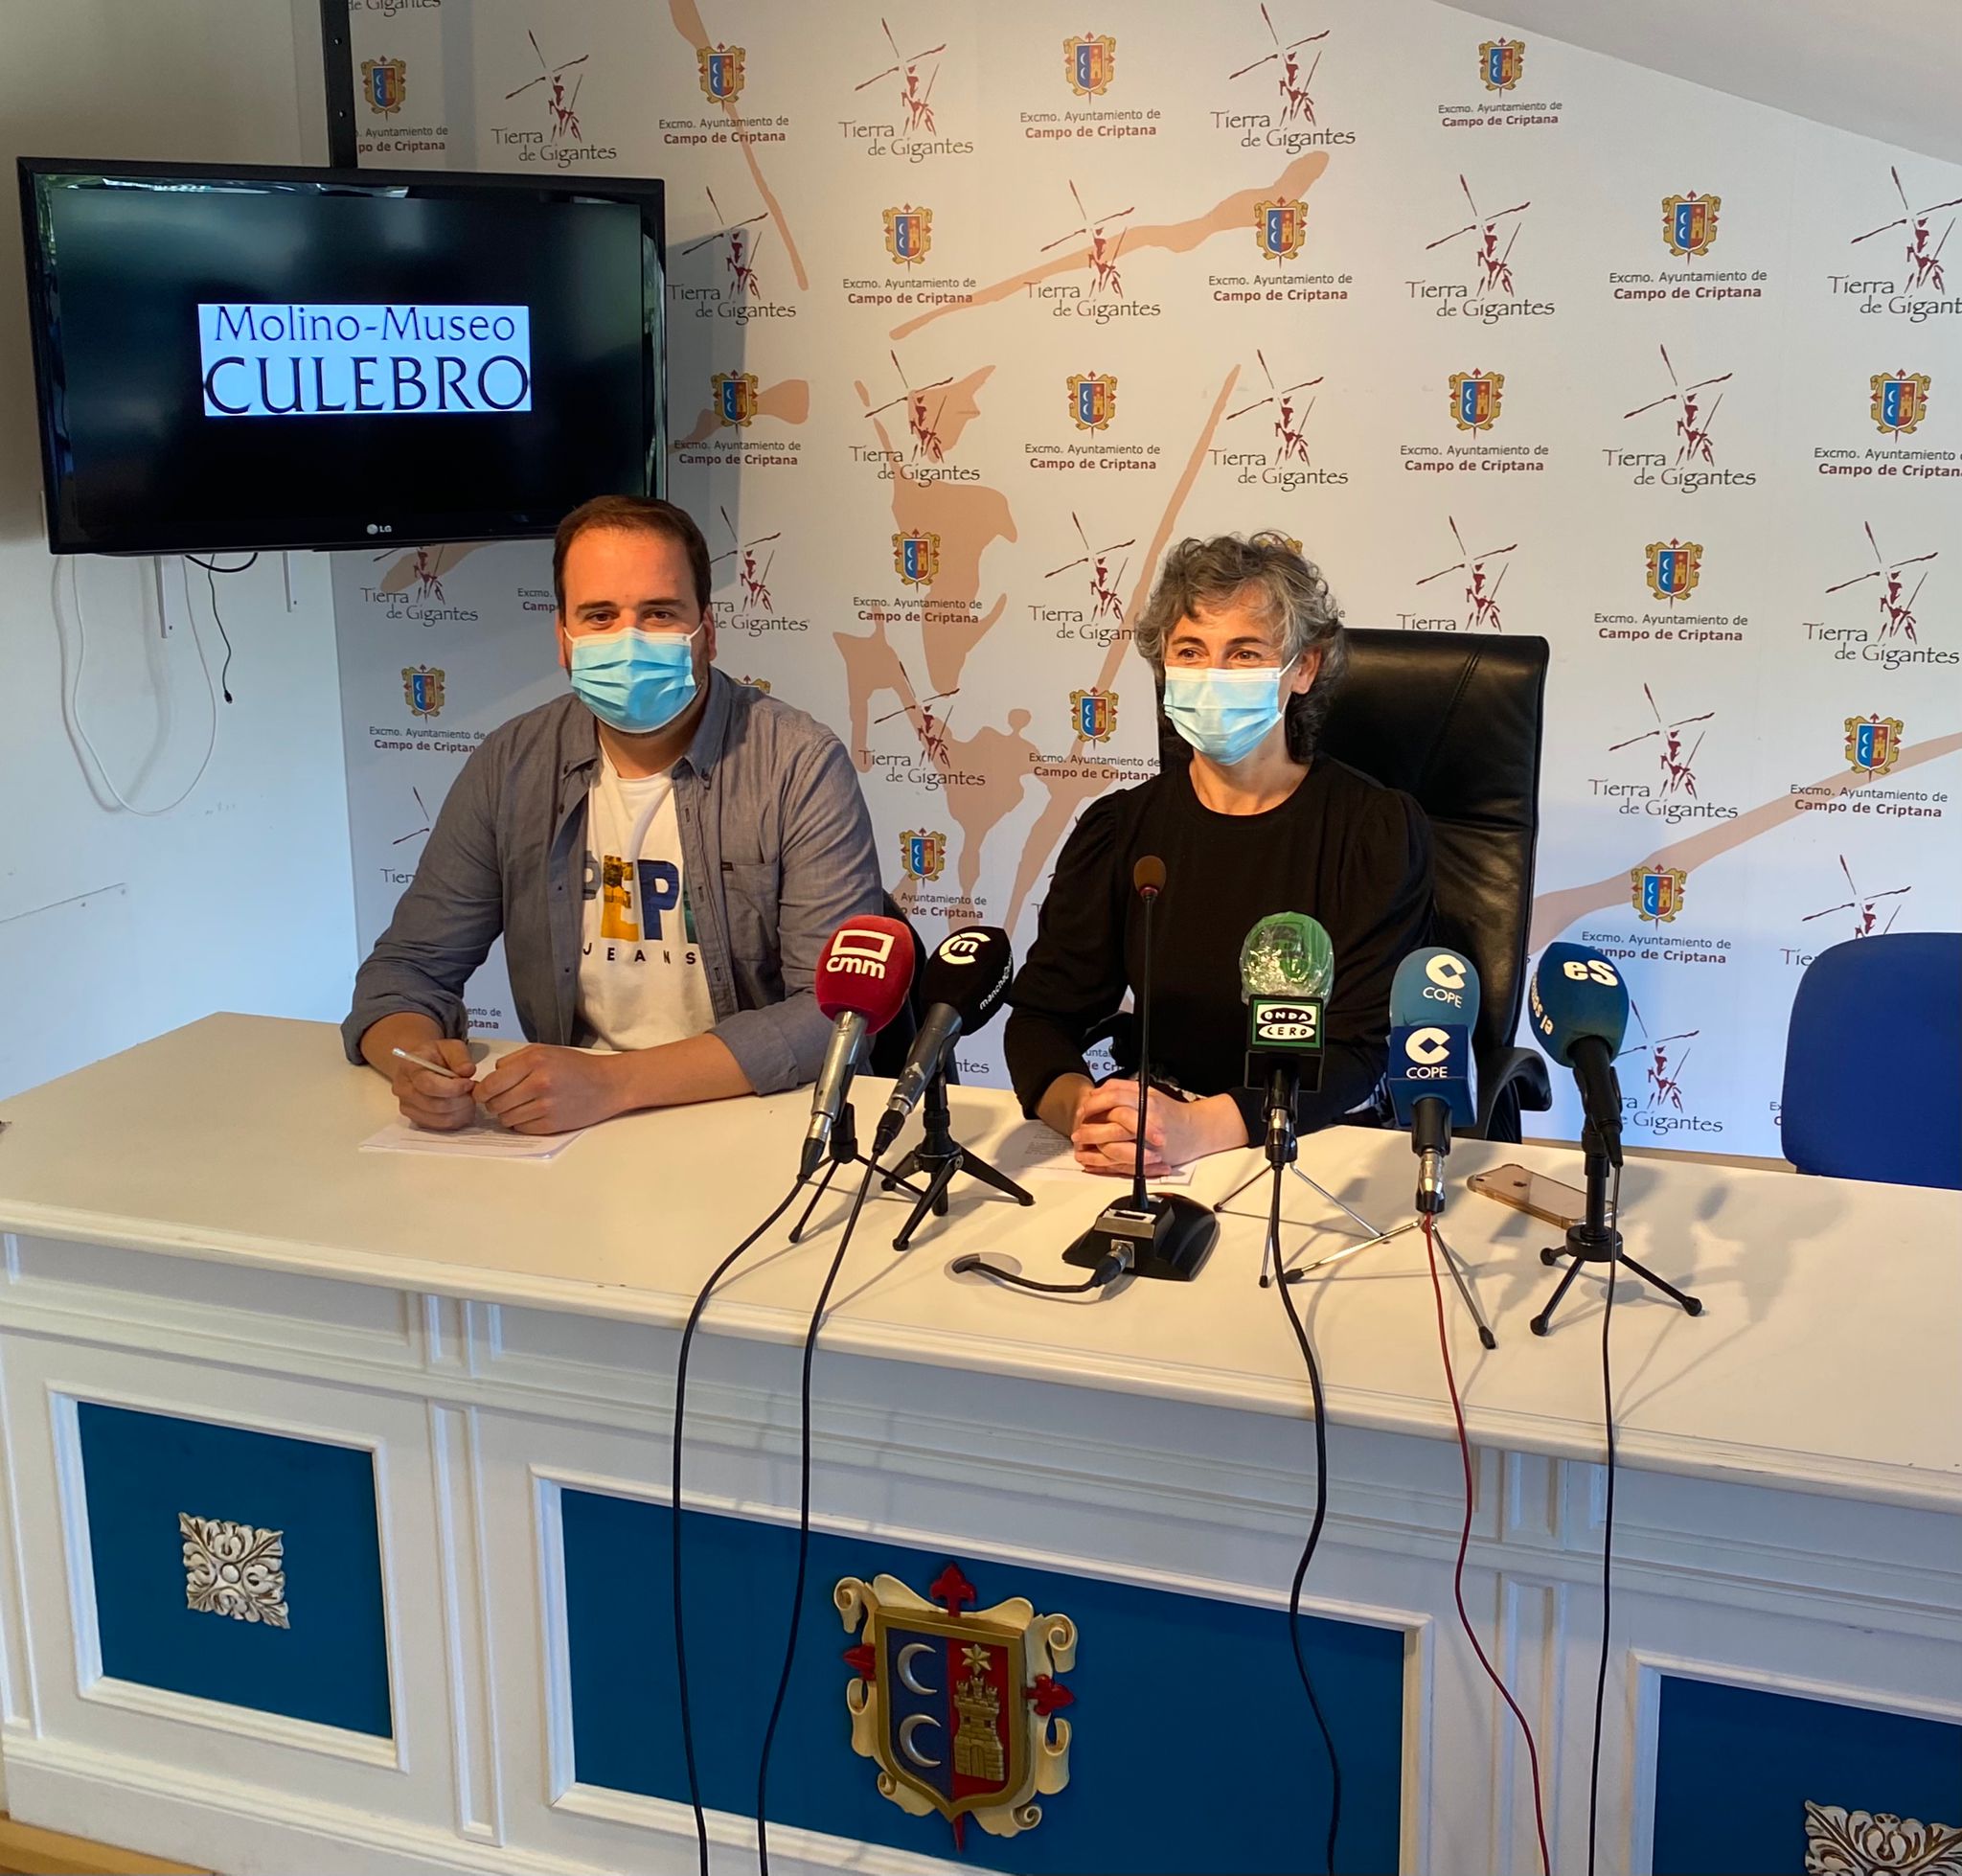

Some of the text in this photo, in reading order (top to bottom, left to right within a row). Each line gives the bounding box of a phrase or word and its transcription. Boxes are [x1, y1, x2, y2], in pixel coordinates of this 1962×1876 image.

[1020, 109, 1160, 123] Excmo. Ayuntamiento de
[1439, 102, 1563, 114] Excmo. Ayuntamiento de
[659, 116, 788, 129] Excmo. Ayuntamiento de
[1210, 110, 1270, 128] Tierra
[1442, 115, 1558, 127] Campo de Criptana
[366, 127, 433, 139] Ayuntamiento
[490, 127, 543, 144] Tierra
[838, 121, 894, 138] Tierra
[1026, 125, 1156, 140] Campo de Criptana
[395, 141, 445, 152] Criptana
[664, 131, 786, 146] Campo de Criptana
[1242, 127, 1356, 154] de Gigantes
[519, 145, 616, 168] de Gigantes
[868, 138, 973, 163] de Gigantes
[843, 278, 976, 290] Excmo. Ayuntamiento de
[1209, 274, 1352, 286] Excmo. Ayuntamiento de
[1609, 270, 1767, 284] Excmo. Ayuntamiento de
[1827, 275, 1894, 294] Tierra
[667, 285, 720, 300] Tierra
[1023, 281, 1080, 298] Tierra
[1214, 289, 1347, 303] Campo de Criptana
[1405, 280, 1467, 298] Tierra
[1614, 286, 1761, 301] Campo de Criptana
[848, 292, 972, 306] Campo de Criptana
[1859, 295, 1882, 313] de
[696, 301, 796, 326] de Gigantes
[1053, 299, 1160, 325] de Gigantes
[1437, 298, 1555, 325] de Gigantes
[215, 306, 515, 341] Molino-Museo
[203, 355, 528, 414] CULEBRO
[674, 440, 785, 451] Excmo. Ayuntamiento
[1025, 444, 1160, 455] Excmo. Ayuntamiento de
[1401, 446, 1548, 457] Excmo. Ayuntamiento de
[679, 454, 797, 467] Campo Criptana
[849, 446, 903, 462] Tierra
[1208, 448, 1266, 466] Tierra
[1603, 448, 1666, 466] Tierra
[1814, 447, 1955, 461] Excmo. Ayuntamiento
[1030, 458, 1156, 471] Campo de Criptana
[1405, 460, 1543, 473] Campo de Criptana
[1818, 464, 1897, 477] Campo de
[878, 463, 980, 488] de Gigantes
[1238, 467, 1348, 492] de Gigantes
[1634, 468, 1756, 493] de Gigantes
[360, 587, 409, 604] Tierra
[854, 597, 966, 608] Excmo. Ayuntamiento
[386, 603, 478, 627] de Gigantes
[858, 610, 978, 625] Campo de Criptana
[1028, 606, 1083, 622] Tierra
[1594, 613, 1747, 626] Excmo. Ayuntamiento de
[731, 614, 809, 637] Gigantes
[1397, 613, 1456, 632] Tierra
[1057, 623, 1074, 639] de
[1599, 629, 1743, 643] Campo de Criptana
[1803, 623, 1867, 642] Tierra
[1835, 642, 1959, 670] de Gigantes
[370, 726, 470, 739] Excmo. Ayuntamiento
[375, 740, 475, 753] Campo Criptan
[858, 750, 911, 766] Tierra
[1030, 753, 1161, 766] Excmo. Ayuntamiento de
[886, 766, 985, 790] de Gigantes
[1034, 766, 1077, 779] Campo
[1082, 768, 1097, 778] de
[1588, 779, 1650, 797] Tierra
[1791, 785, 1948, 802] Excmo. Ayuntamiento de
[1619, 797, 1738, 824] de Gigantes
[1795, 799, 1942, 817] Campo de Criptana
[582, 850, 697, 944] PEP
[901, 893, 970, 905] Ayuntamiento
[930, 906, 983, 919] Criptana
[1583, 931, 1731, 949] Excmo. Ayuntamiento de
[582, 943, 696, 965] JEANS
[1641, 949, 1726, 964] de Criptana
[826, 956, 886, 980] cmm
[1423, 987, 1463, 1009] COPE
[1264, 1011, 1309, 1020] ONDA
[1266, 1026, 1308, 1036] CERO
[1406, 1066, 1448, 1080] COPE
[1633, 1110, 1723, 1135] Gigantes
